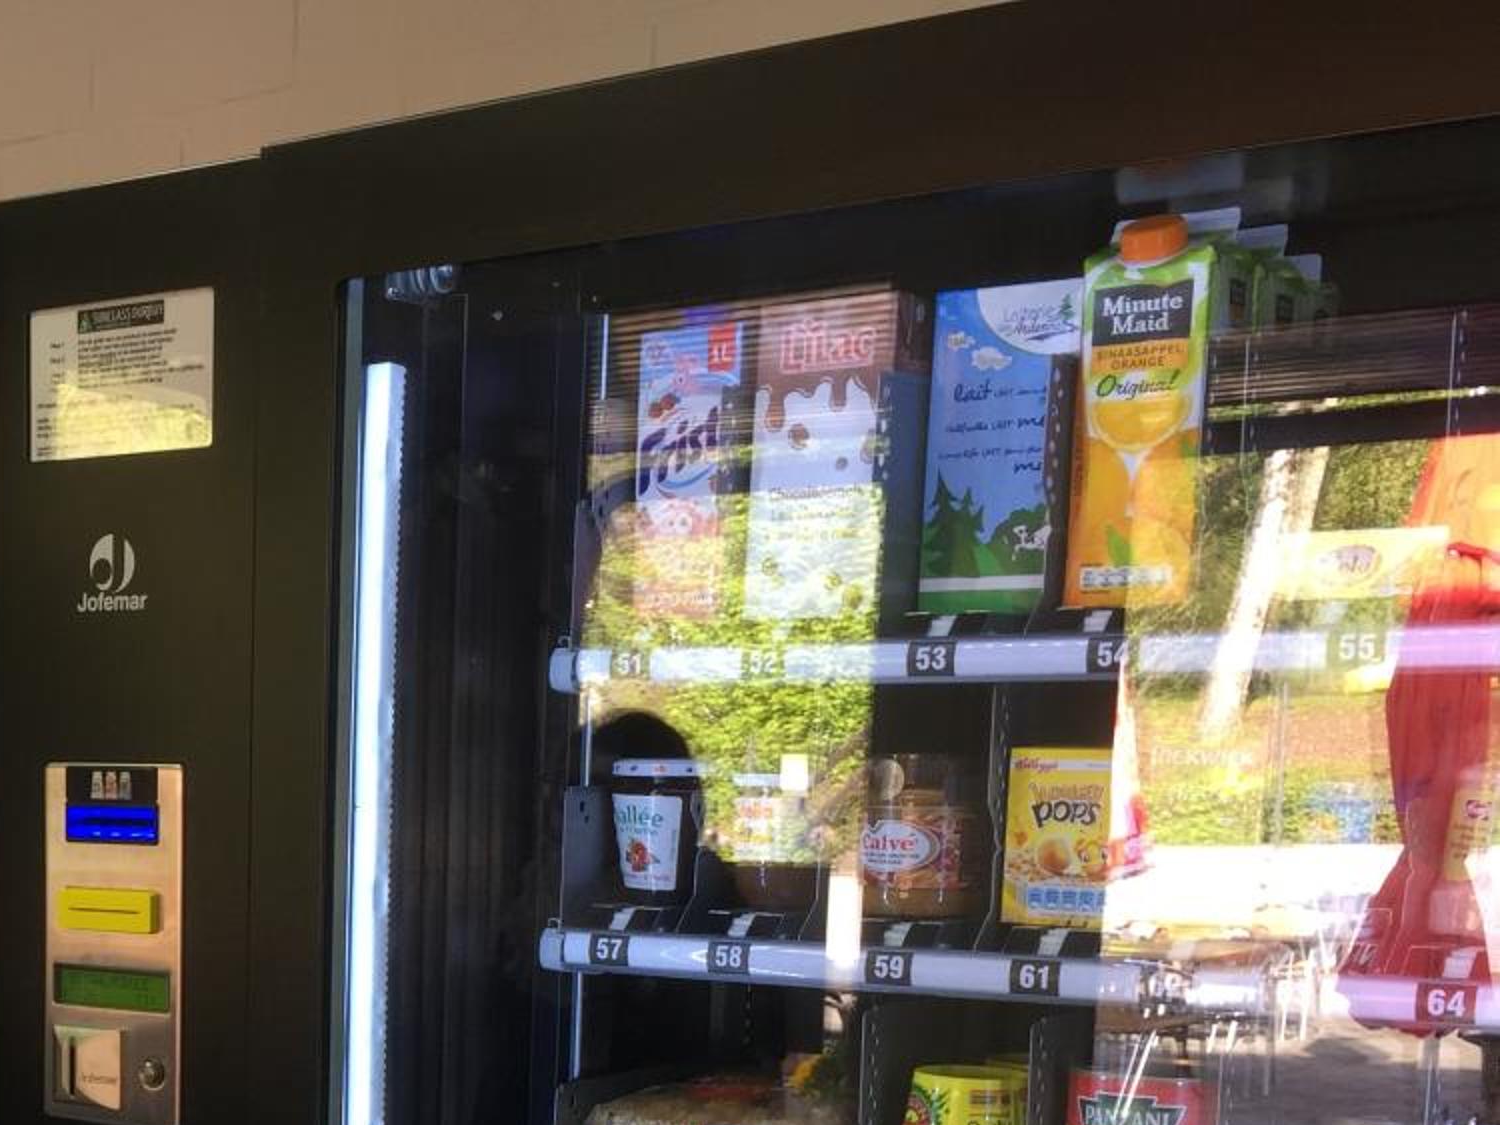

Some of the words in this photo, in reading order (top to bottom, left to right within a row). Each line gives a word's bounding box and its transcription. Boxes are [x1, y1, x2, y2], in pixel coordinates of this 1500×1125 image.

[1101, 290, 1183, 317] Minute
[1110, 312, 1171, 336] Maid
[1111, 355, 1165, 370] ORANGE
[1096, 369, 1181, 400] Original
[77, 592, 148, 615] Jofemar
[915, 645, 949, 670] 53
[1339, 632, 1376, 660] 55
[596, 937, 621, 960] 57
[714, 945, 743, 969] 58
[873, 956, 905, 980] 59
[1018, 963, 1051, 989] 61
[1427, 991, 1466, 1017] 64
